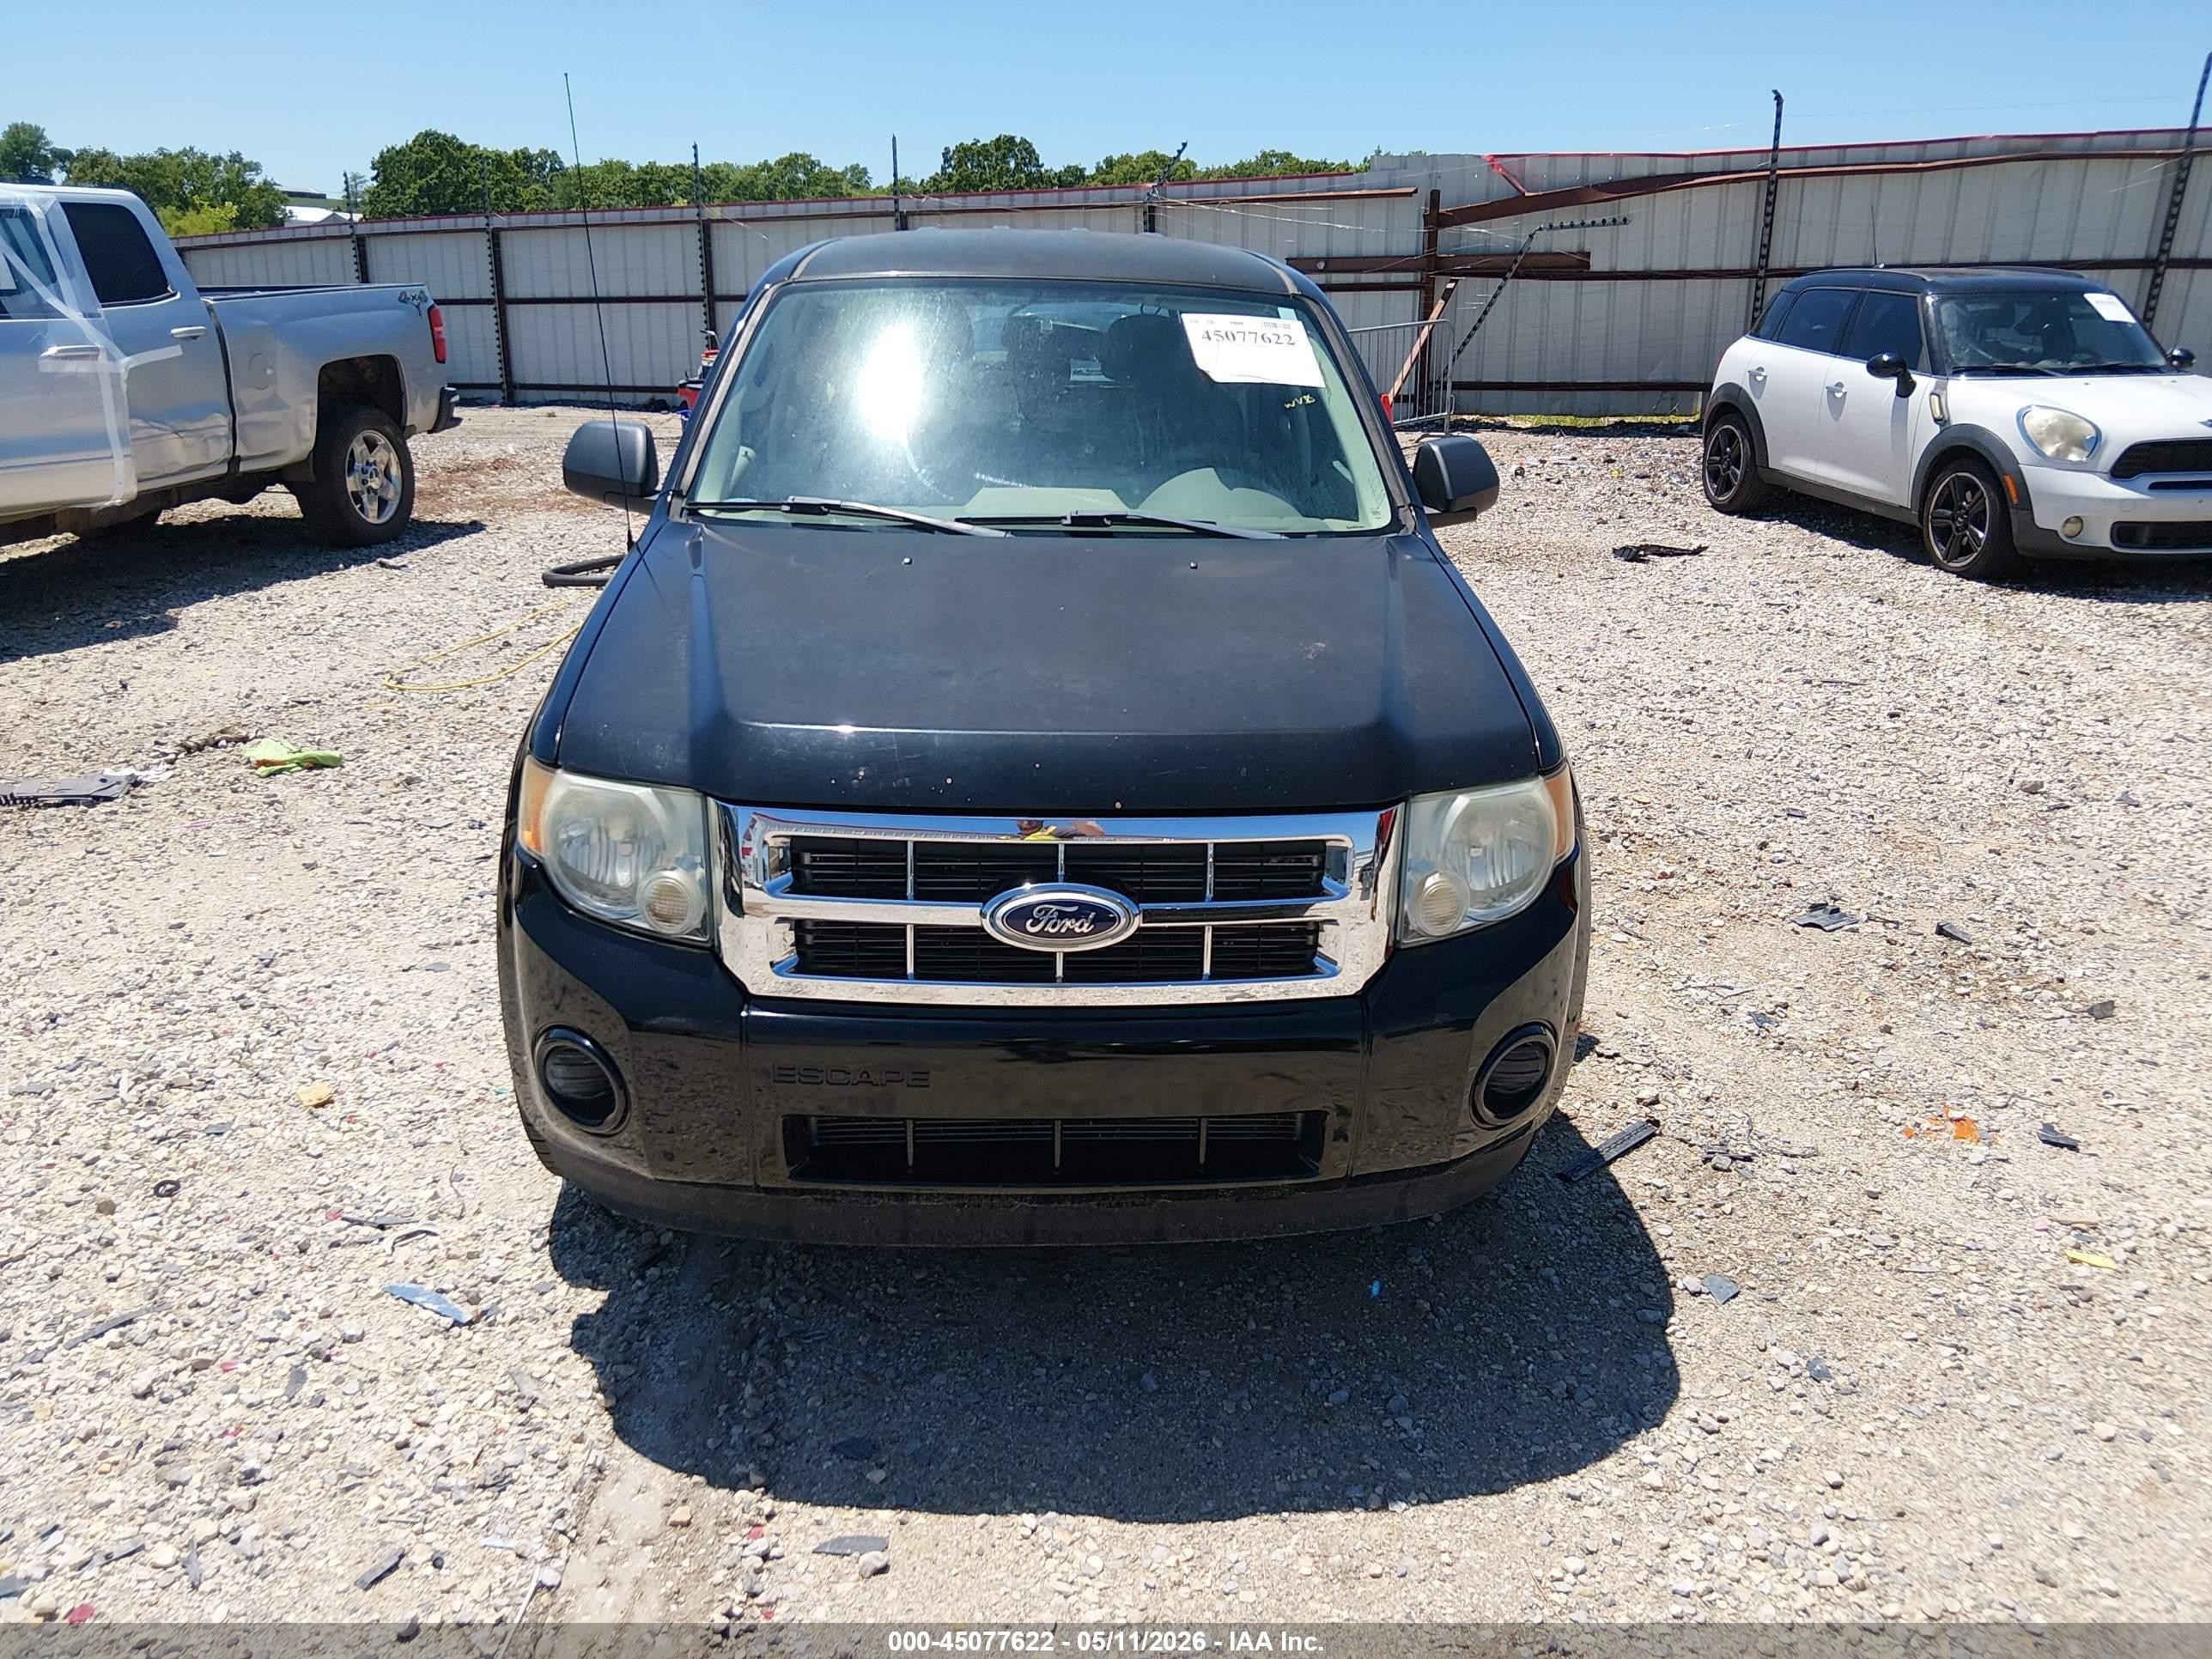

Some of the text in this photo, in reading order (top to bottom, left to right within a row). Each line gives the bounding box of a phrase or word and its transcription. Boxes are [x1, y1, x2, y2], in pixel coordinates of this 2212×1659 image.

[1201, 329, 1296, 345] 45077622
[1025, 904, 1096, 933] Ford
[773, 1065, 930, 1087] ESCAPE
